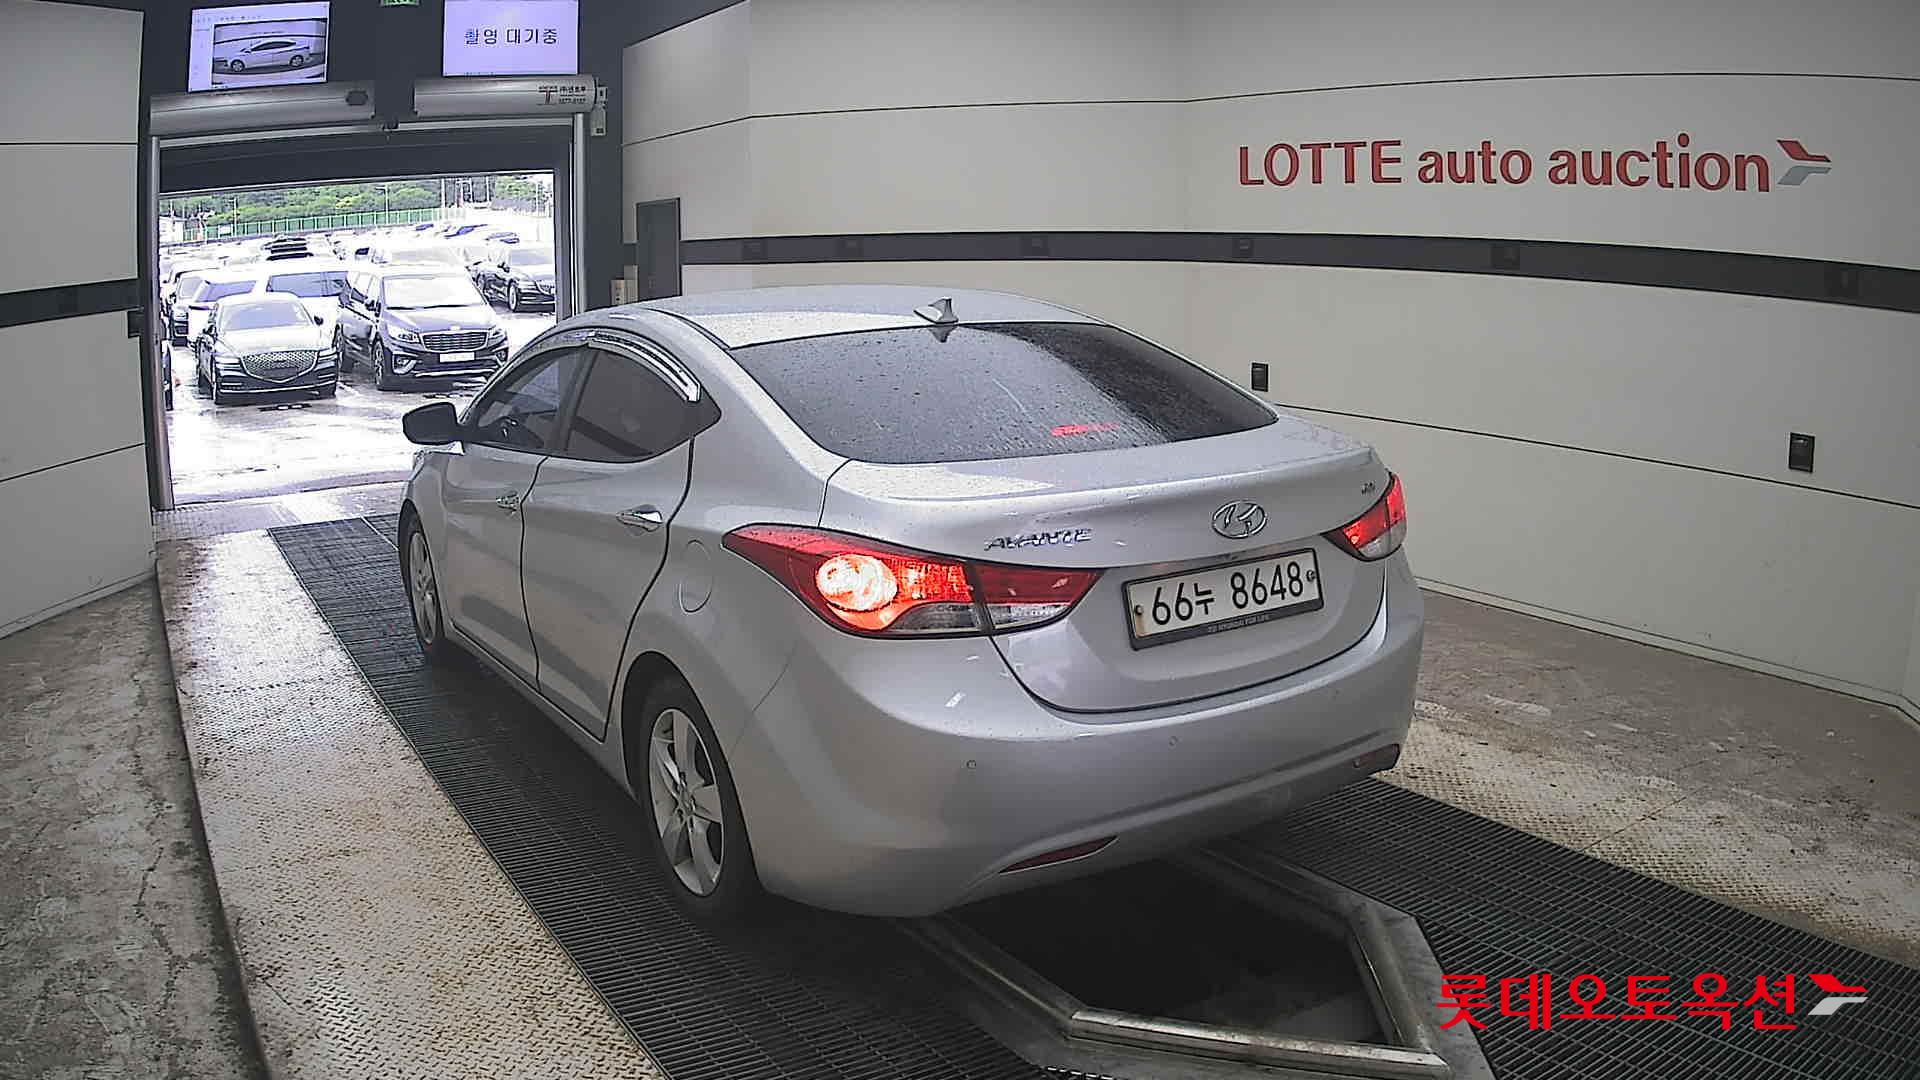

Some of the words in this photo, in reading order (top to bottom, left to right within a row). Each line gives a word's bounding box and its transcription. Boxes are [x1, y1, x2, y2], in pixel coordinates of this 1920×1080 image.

[506, 28, 558, 45] 대기중
[1239, 139, 1402, 187] LOTTE
[1417, 140, 1533, 185] auto
[1547, 132, 1771, 193] auction
[1152, 582, 1216, 626] 66누
[1229, 561, 1304, 609] 8648
